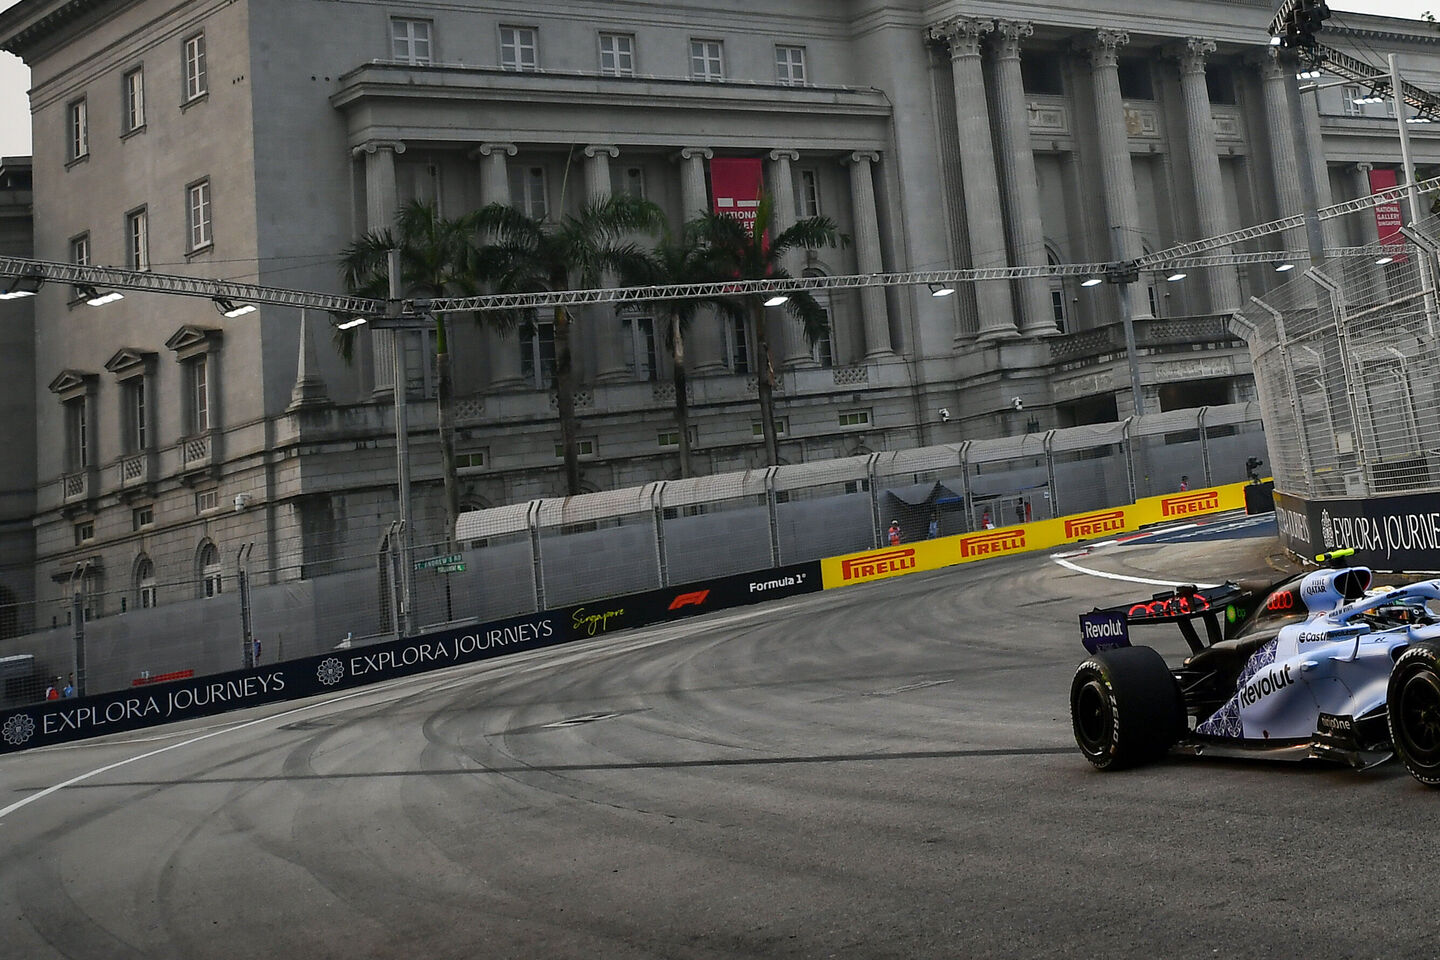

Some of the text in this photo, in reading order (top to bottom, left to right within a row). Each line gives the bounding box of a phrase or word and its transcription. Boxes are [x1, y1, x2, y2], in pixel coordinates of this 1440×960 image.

[1161, 491, 1219, 517] PIRELLI
[1064, 510, 1125, 538] PIRELLI
[1333, 517, 1383, 551] EXPLORA
[960, 529, 1026, 558] PIRELLI
[842, 548, 916, 580] PIRELLI
[750, 576, 795, 593] Formula
[1306, 585, 1327, 596] QATAR
[572, 606, 625, 636] Singapore
[1085, 619, 1124, 639] Revolut
[351, 619, 553, 676] EXPLORA JOURNEYS
[1240, 664, 1295, 708] Revolut
[43, 672, 285, 734] EXPLORA JOURNEYS
[1109, 695, 1120, 743] ZERO
